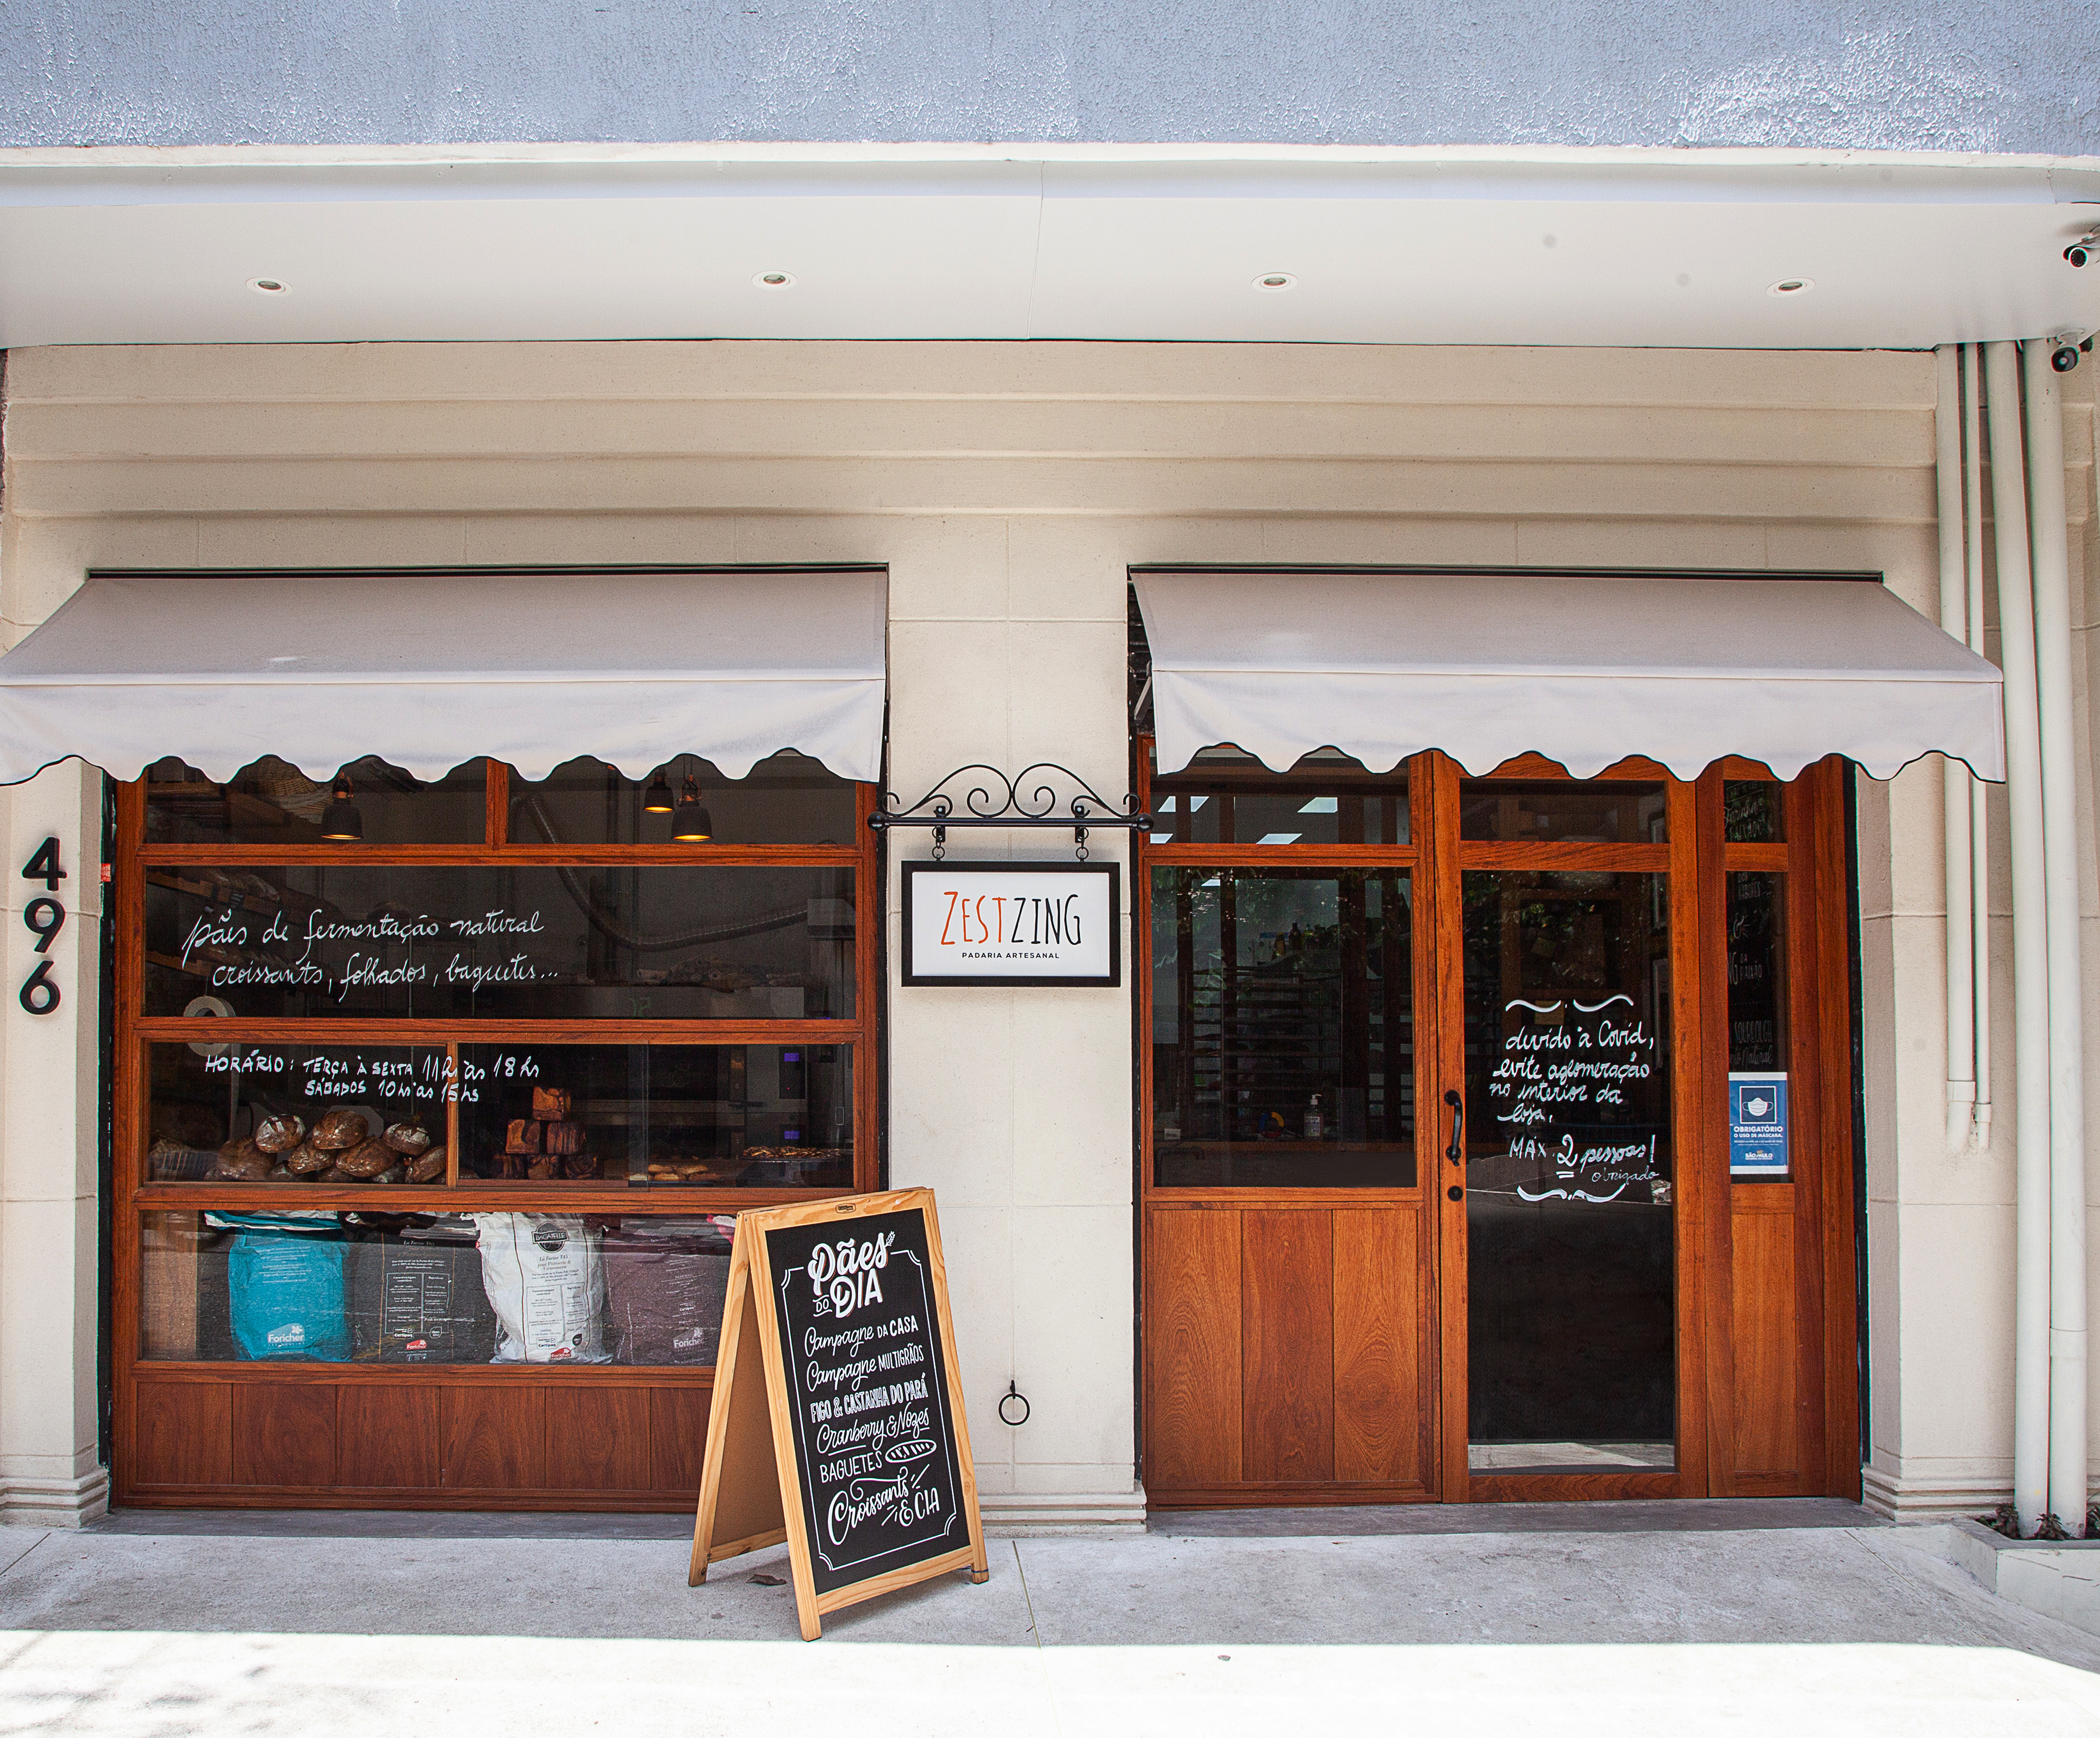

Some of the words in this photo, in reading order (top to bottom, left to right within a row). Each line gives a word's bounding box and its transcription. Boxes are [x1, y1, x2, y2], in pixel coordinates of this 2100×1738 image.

[20, 837, 67, 1015] 496
[262, 910, 289, 944] de
[295, 909, 439, 965] fermentação
[450, 909, 545, 936] natural
[303, 1057, 348, 1080] TERÇA
[371, 1061, 413, 1077] SEXTA
[1493, 1054, 1543, 1080] evite
[1547, 1051, 1650, 1085] aglomeração
[305, 1077, 367, 1097] SÁBADOS
[1489, 1082, 1511, 1097] no
[1517, 1080, 1588, 1102] interior
[1595, 1083, 1623, 1104] da
[1733, 1124, 1783, 1133] OBRIGATÓRIO
[1556, 1134, 1578, 1167] 2
[1591, 1164, 1660, 1185] obrigado
[808, 1232, 888, 1297] Pães
[830, 1268, 883, 1318] DIA
[268, 1333, 304, 1343] Foricher
[674, 1336, 702, 1348] Foricher
[805, 1326, 874, 1357] Campagne
[877, 1325, 888, 1338] DA
[889, 1315, 919, 1336] CASA
[807, 1358, 877, 1392] Campagne
[878, 1343, 924, 1372] MULTIGRÃOS
[810, 1399, 832, 1423] FIGO
[833, 1397, 844, 1417] &
[844, 1386, 890, 1414] CASTANHA
[889, 1383, 904, 1404] DO
[904, 1372, 929, 1399] PARÁ
[816, 1419, 887, 1454] Cranberry
[886, 1415, 900, 1438] &
[897, 1402, 930, 1439] Nozes
[820, 1450, 883, 1483] BAGUETES
[827, 1466, 909, 1546] Croissants
